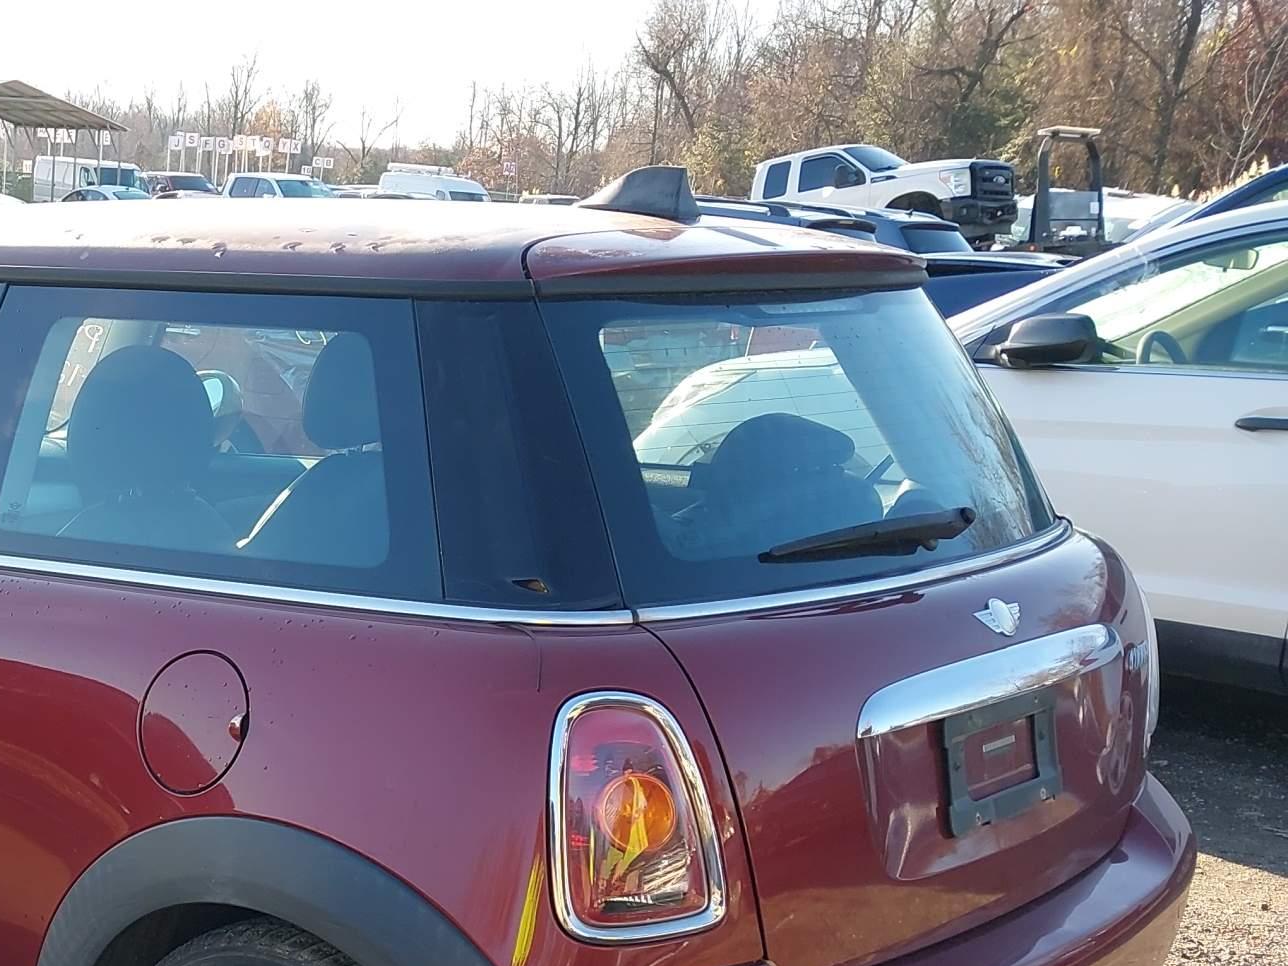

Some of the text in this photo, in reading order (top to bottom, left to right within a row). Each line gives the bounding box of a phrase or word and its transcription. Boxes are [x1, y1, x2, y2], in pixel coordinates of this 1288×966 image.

[174, 138, 180, 148] J
[188, 135, 195, 145] S
[204, 139, 211, 149] F
[218, 139, 225, 149] G
[292, 141, 300, 152] X
[314, 158, 321, 166] C
